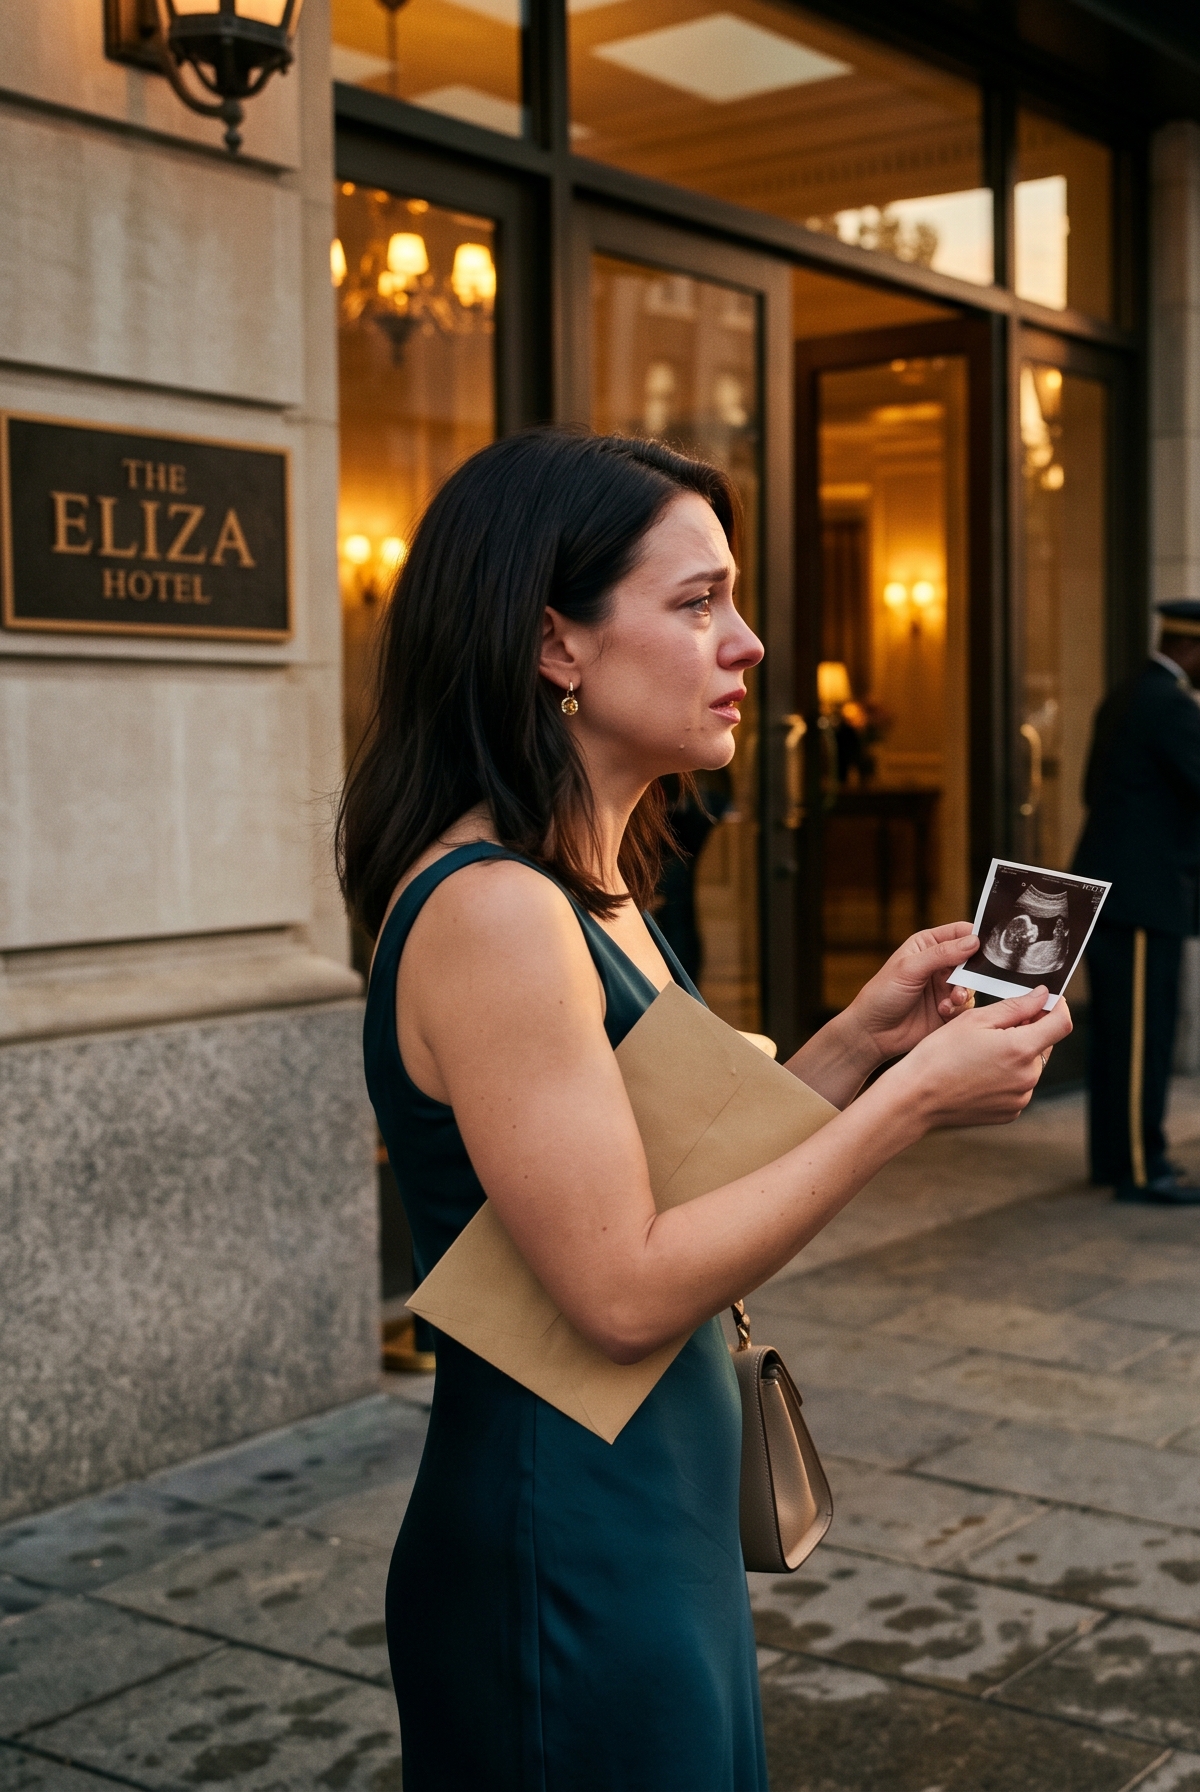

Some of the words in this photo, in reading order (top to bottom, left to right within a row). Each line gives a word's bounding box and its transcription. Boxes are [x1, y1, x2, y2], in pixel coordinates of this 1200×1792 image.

[123, 458, 187, 494] THE
[51, 491, 256, 568] ELIZA
[103, 568, 211, 604] HOTEL
